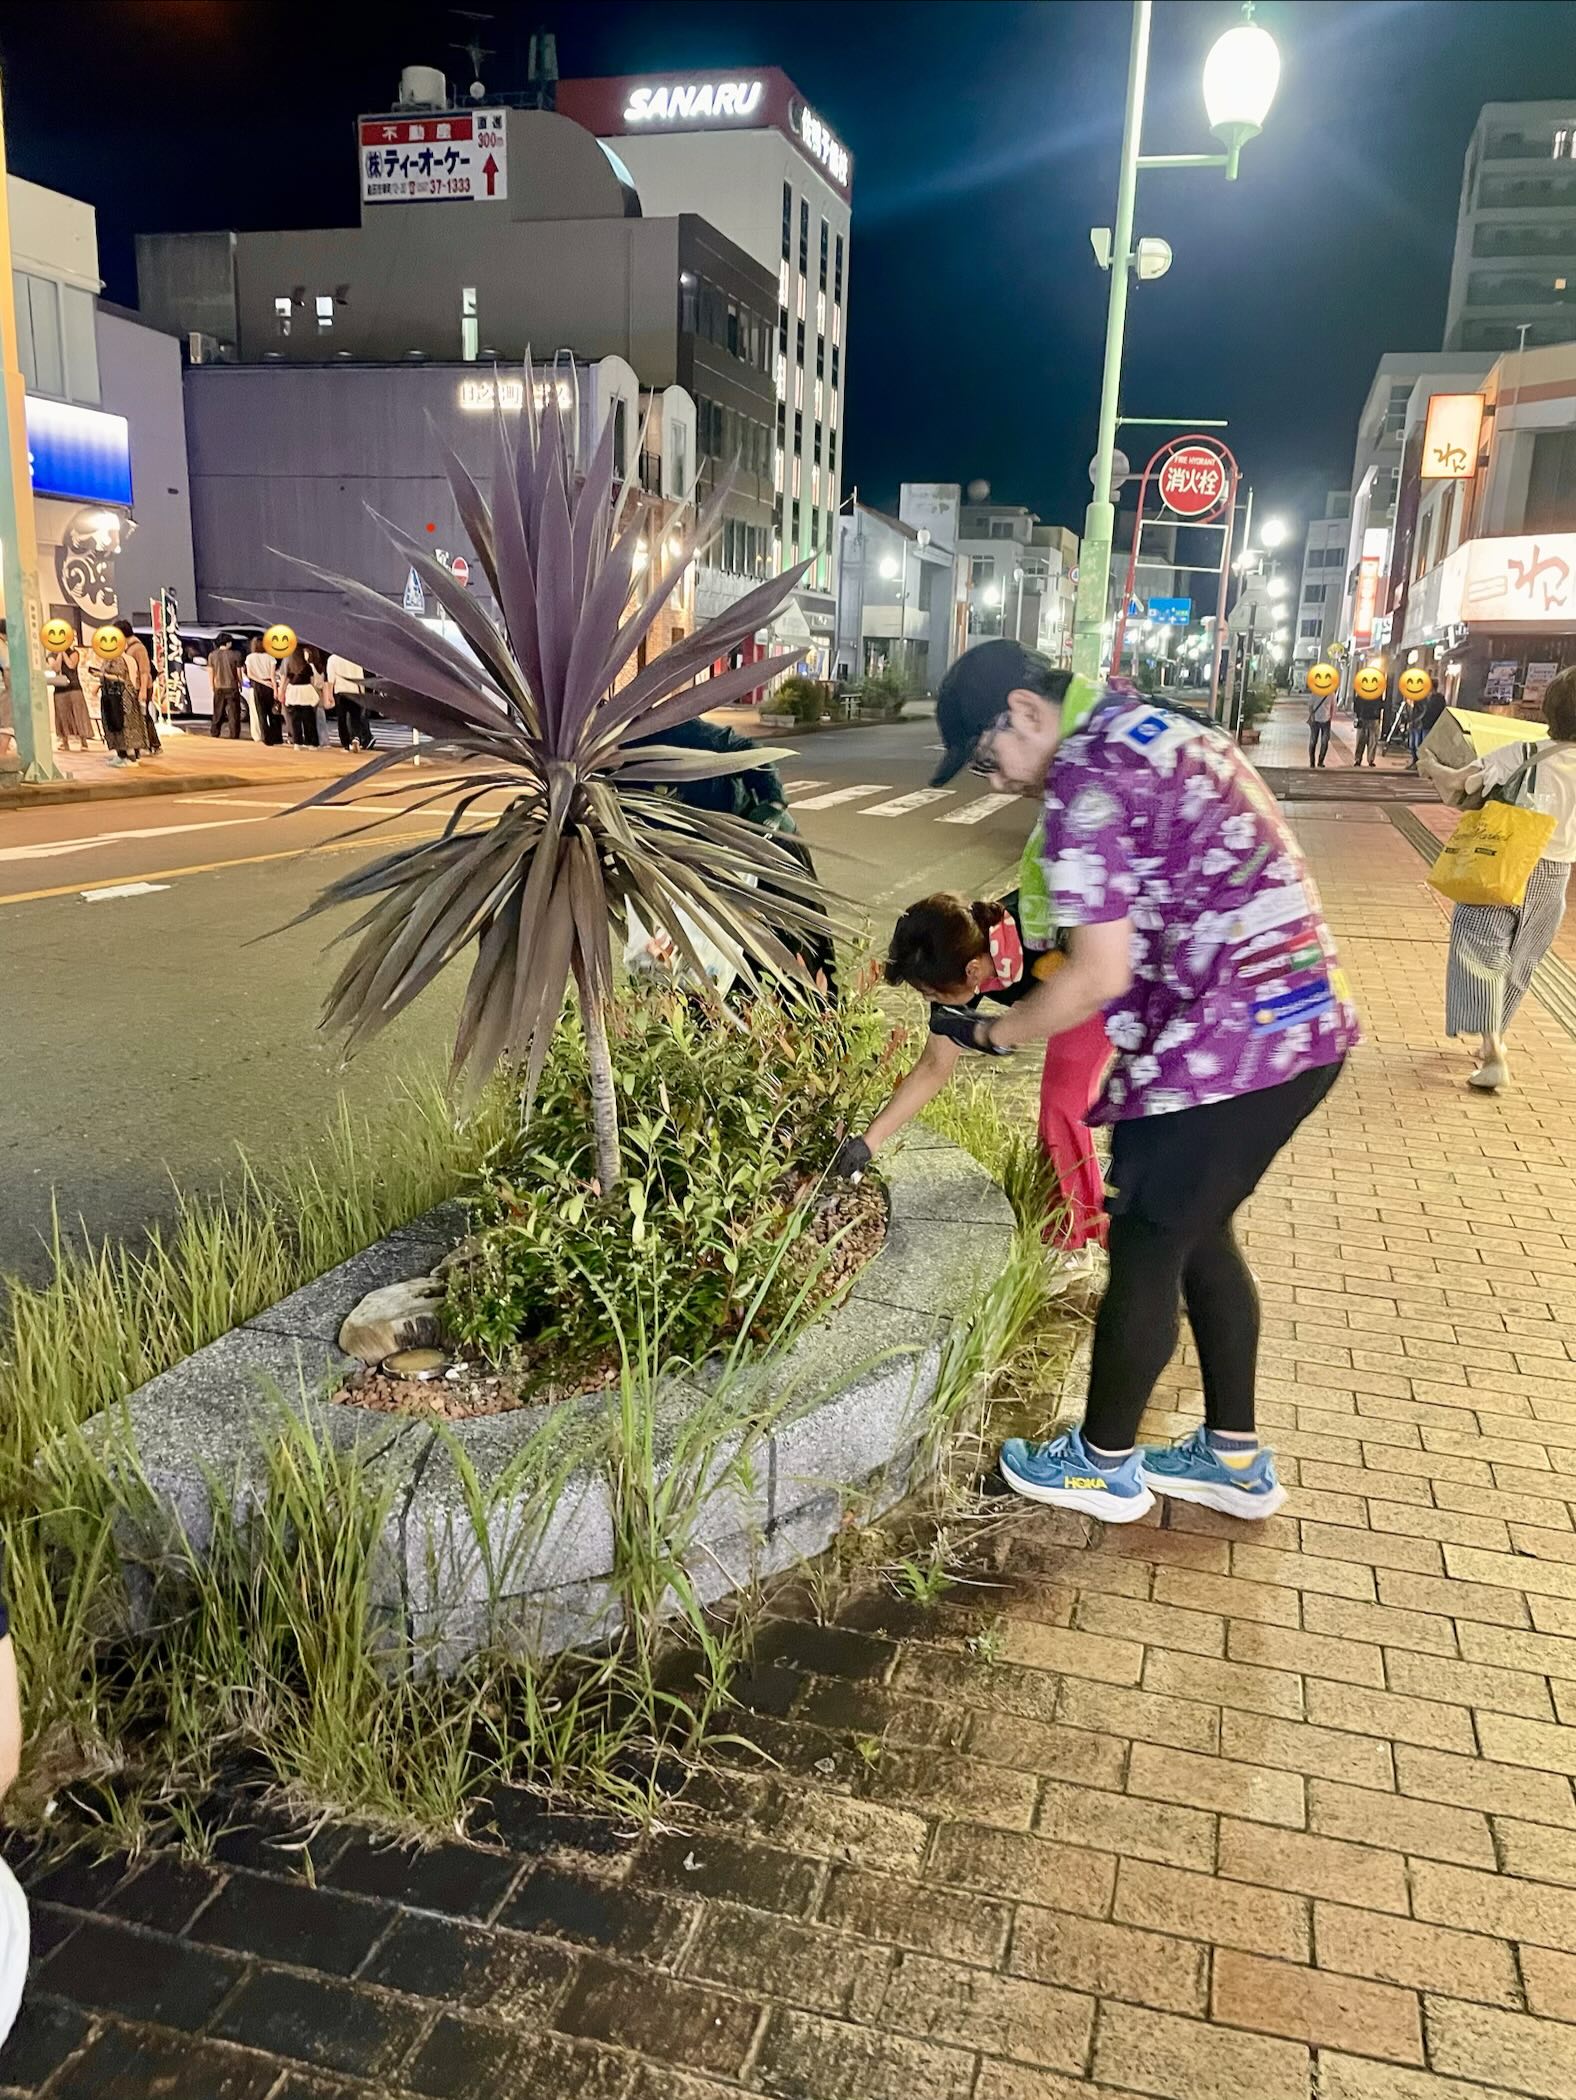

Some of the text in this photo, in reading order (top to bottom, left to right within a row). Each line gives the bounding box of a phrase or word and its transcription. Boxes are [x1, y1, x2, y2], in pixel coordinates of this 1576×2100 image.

[624, 82, 762, 120] SANARU
[1174, 456, 1188, 464] FIRE
[1165, 467, 1219, 495] 消火栓
[1064, 1475, 1108, 1489] HOKA
